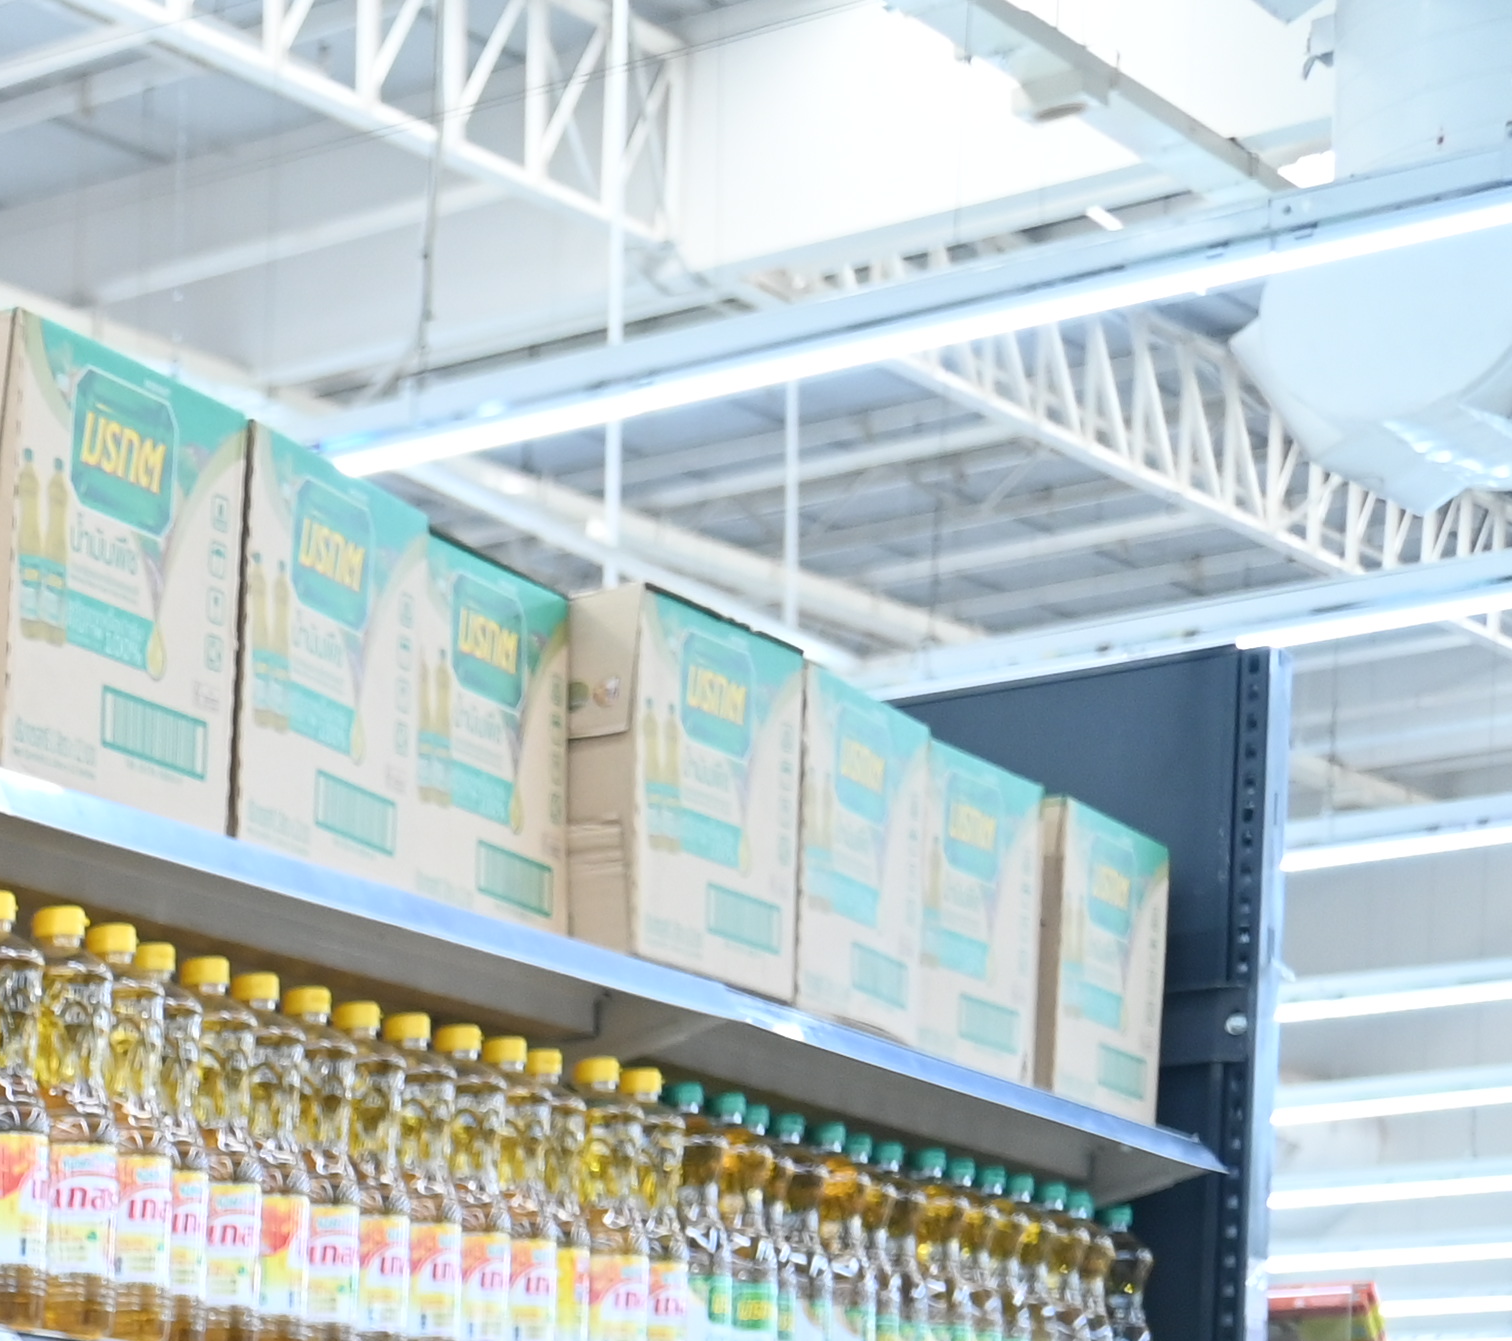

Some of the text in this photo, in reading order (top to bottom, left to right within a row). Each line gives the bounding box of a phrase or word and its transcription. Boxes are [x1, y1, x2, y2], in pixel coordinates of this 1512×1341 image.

[81, 409, 166, 494] มรกต
[300, 523, 363, 593] มรกต
[457, 603, 518, 676] มรกต
[686, 662, 747, 726] มรกต
